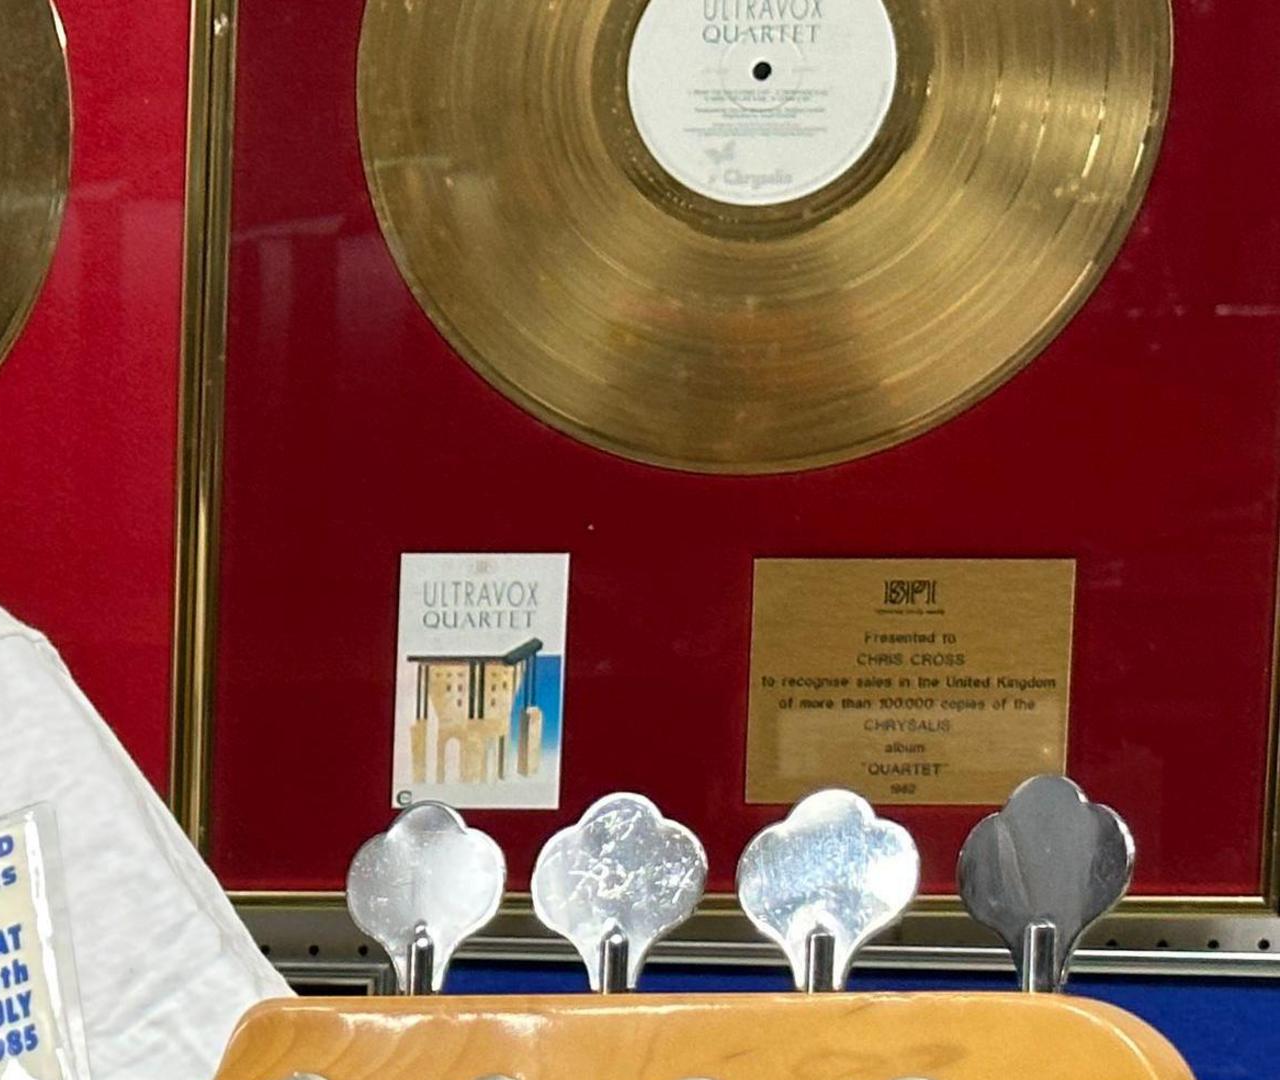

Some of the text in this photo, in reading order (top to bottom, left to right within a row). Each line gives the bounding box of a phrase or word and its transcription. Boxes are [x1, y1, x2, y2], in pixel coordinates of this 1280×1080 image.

[703, 0, 823, 21] ULTRAVOX
[702, 24, 820, 44] QUARTET
[422, 581, 539, 607] ULTRAVOX
[422, 610, 537, 630] QUARTET
[864, 631, 956, 644] Presented to
[857, 653, 965, 666] CHRIS CROSS
[762, 675, 1056, 691] to recognise sales in the United Kingdom
[778, 698, 793, 710] of
[800, 699, 833, 709] more
[842, 698, 871, 710] than
[941, 699, 985, 713] copies
[992, 698, 1006, 710] of
[1014, 698, 1035, 710] the
[864, 718, 950, 733] CHRYSALIS
[884, 742, 925, 754] album
